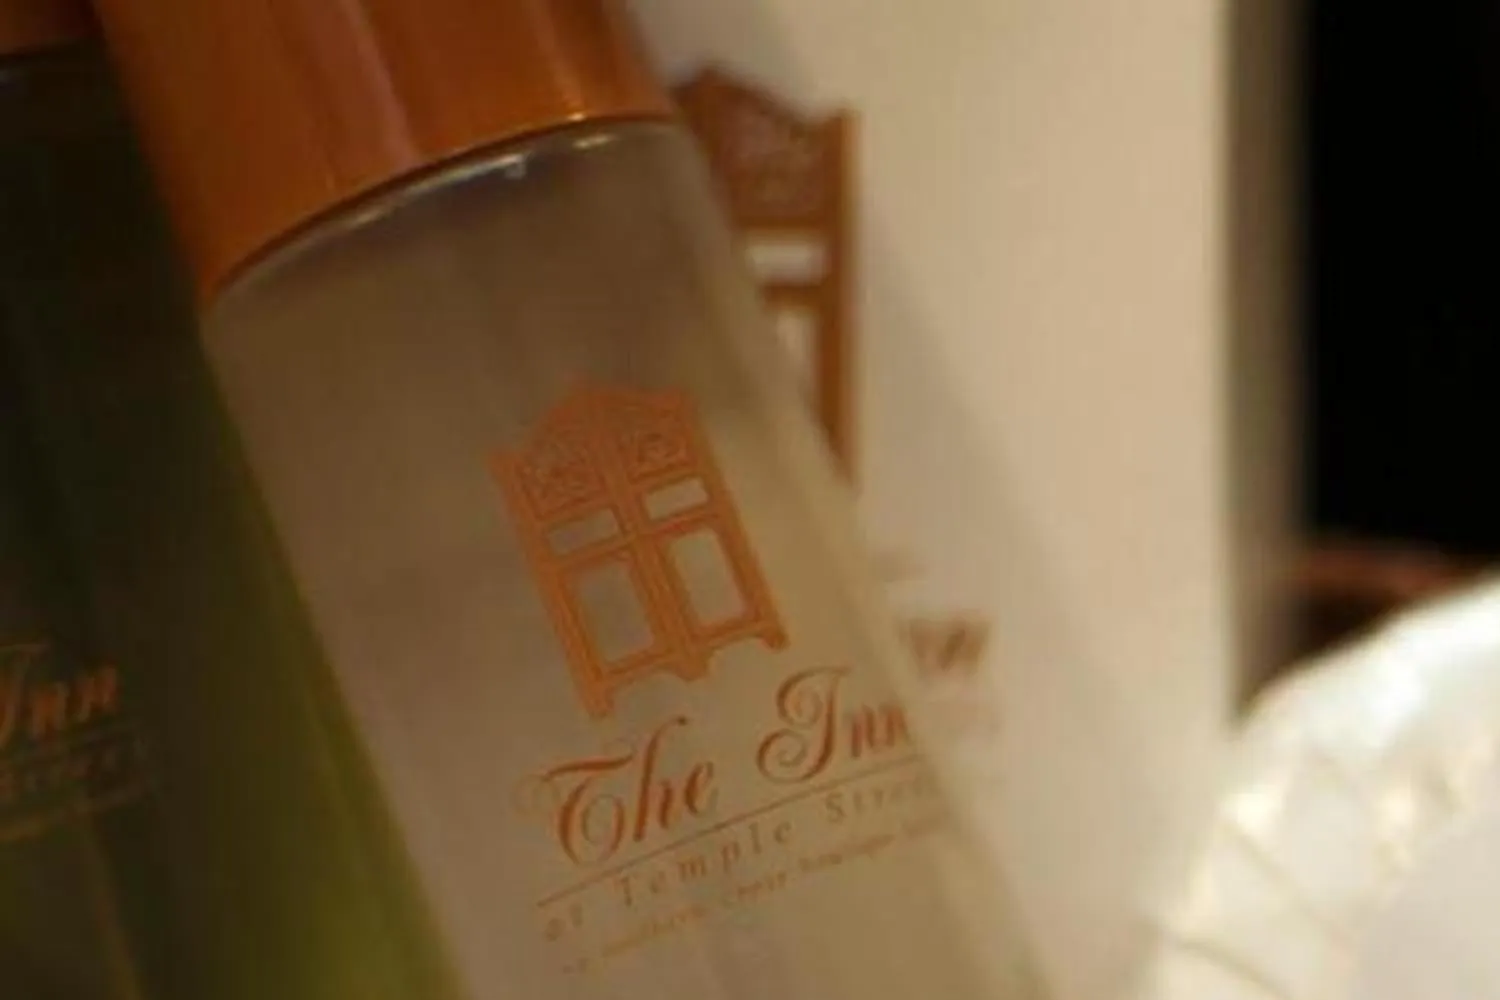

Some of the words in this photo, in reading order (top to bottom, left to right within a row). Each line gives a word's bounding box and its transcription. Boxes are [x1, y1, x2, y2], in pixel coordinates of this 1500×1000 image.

[512, 714, 722, 868] The
[756, 665, 914, 783] Inn
[613, 816, 795, 912] Temple
